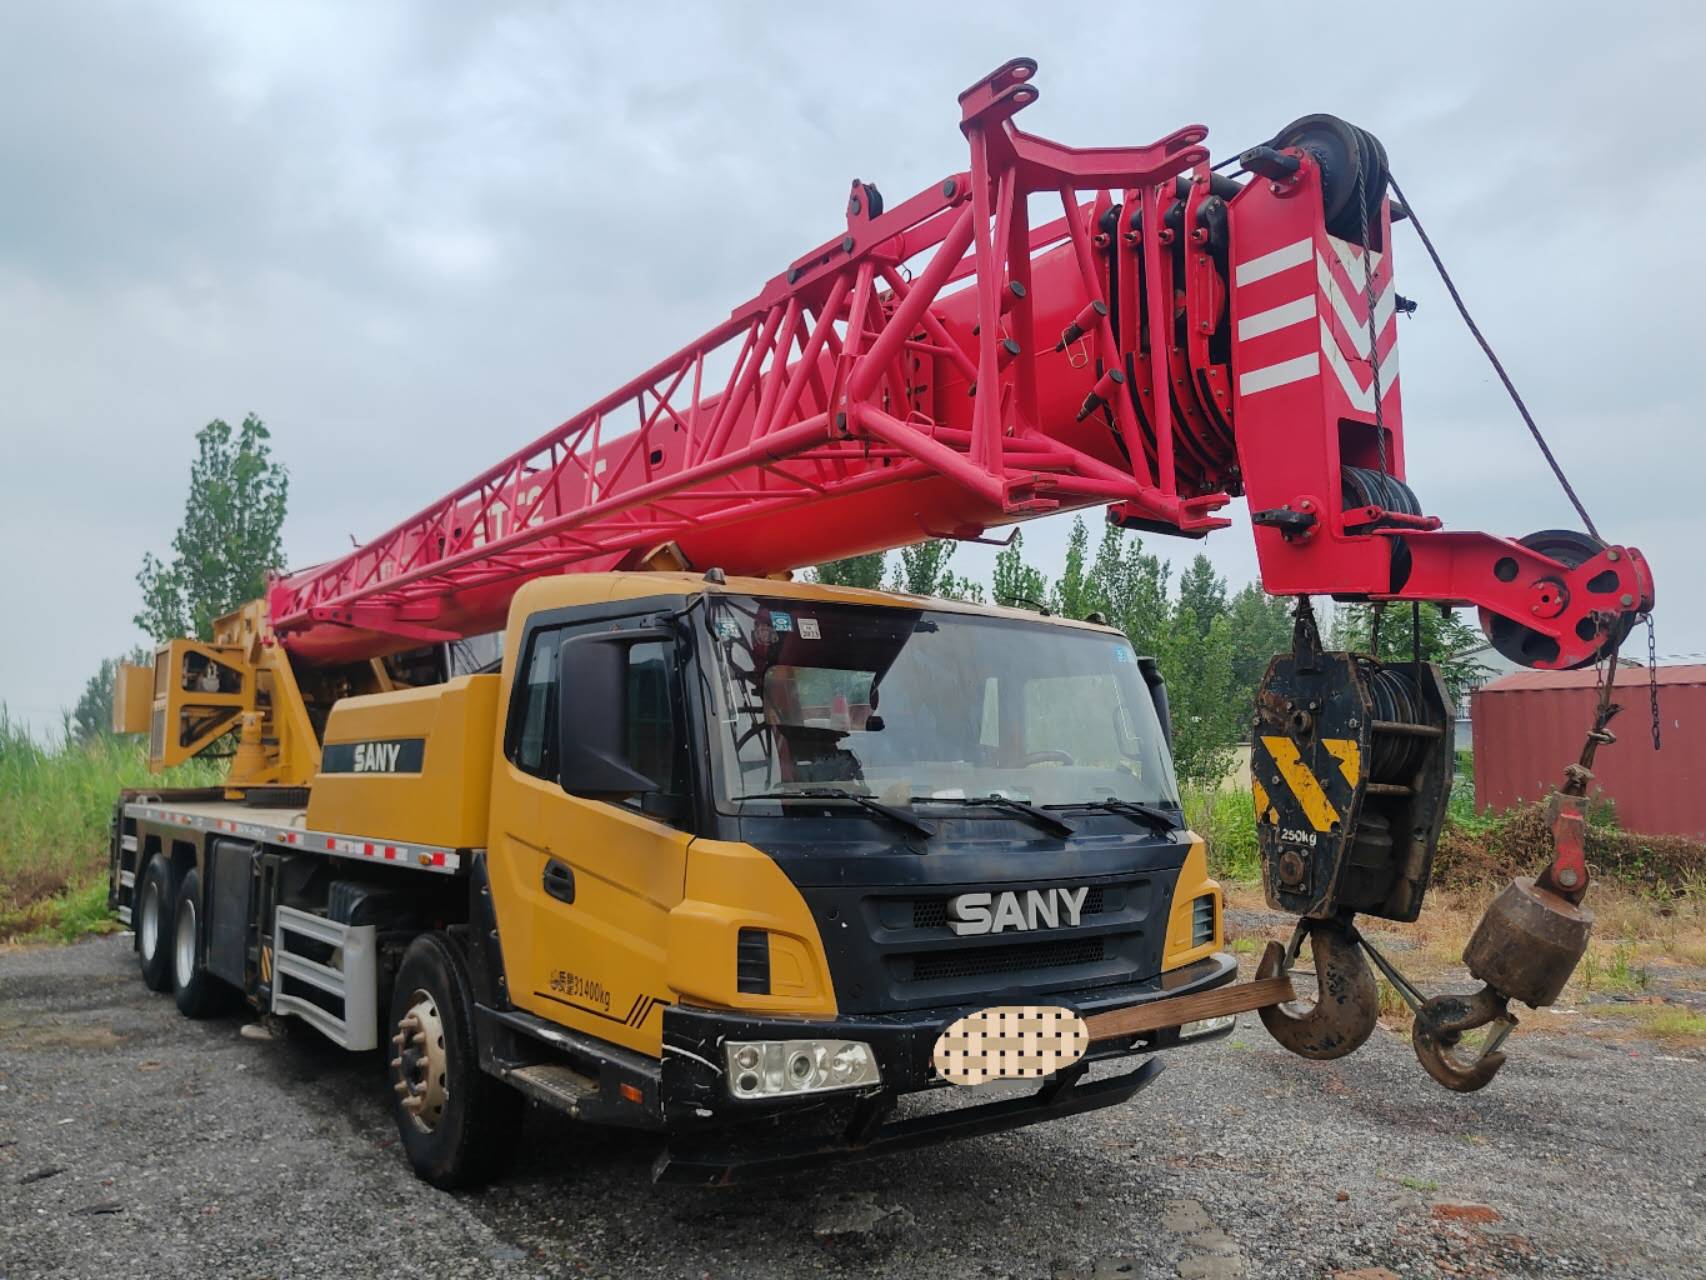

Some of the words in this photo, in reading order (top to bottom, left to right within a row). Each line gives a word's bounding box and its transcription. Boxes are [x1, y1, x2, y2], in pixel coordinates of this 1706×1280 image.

[354, 743, 400, 772] SANY
[1281, 828, 1316, 846] 250kg
[949, 887, 1089, 936] SANY
